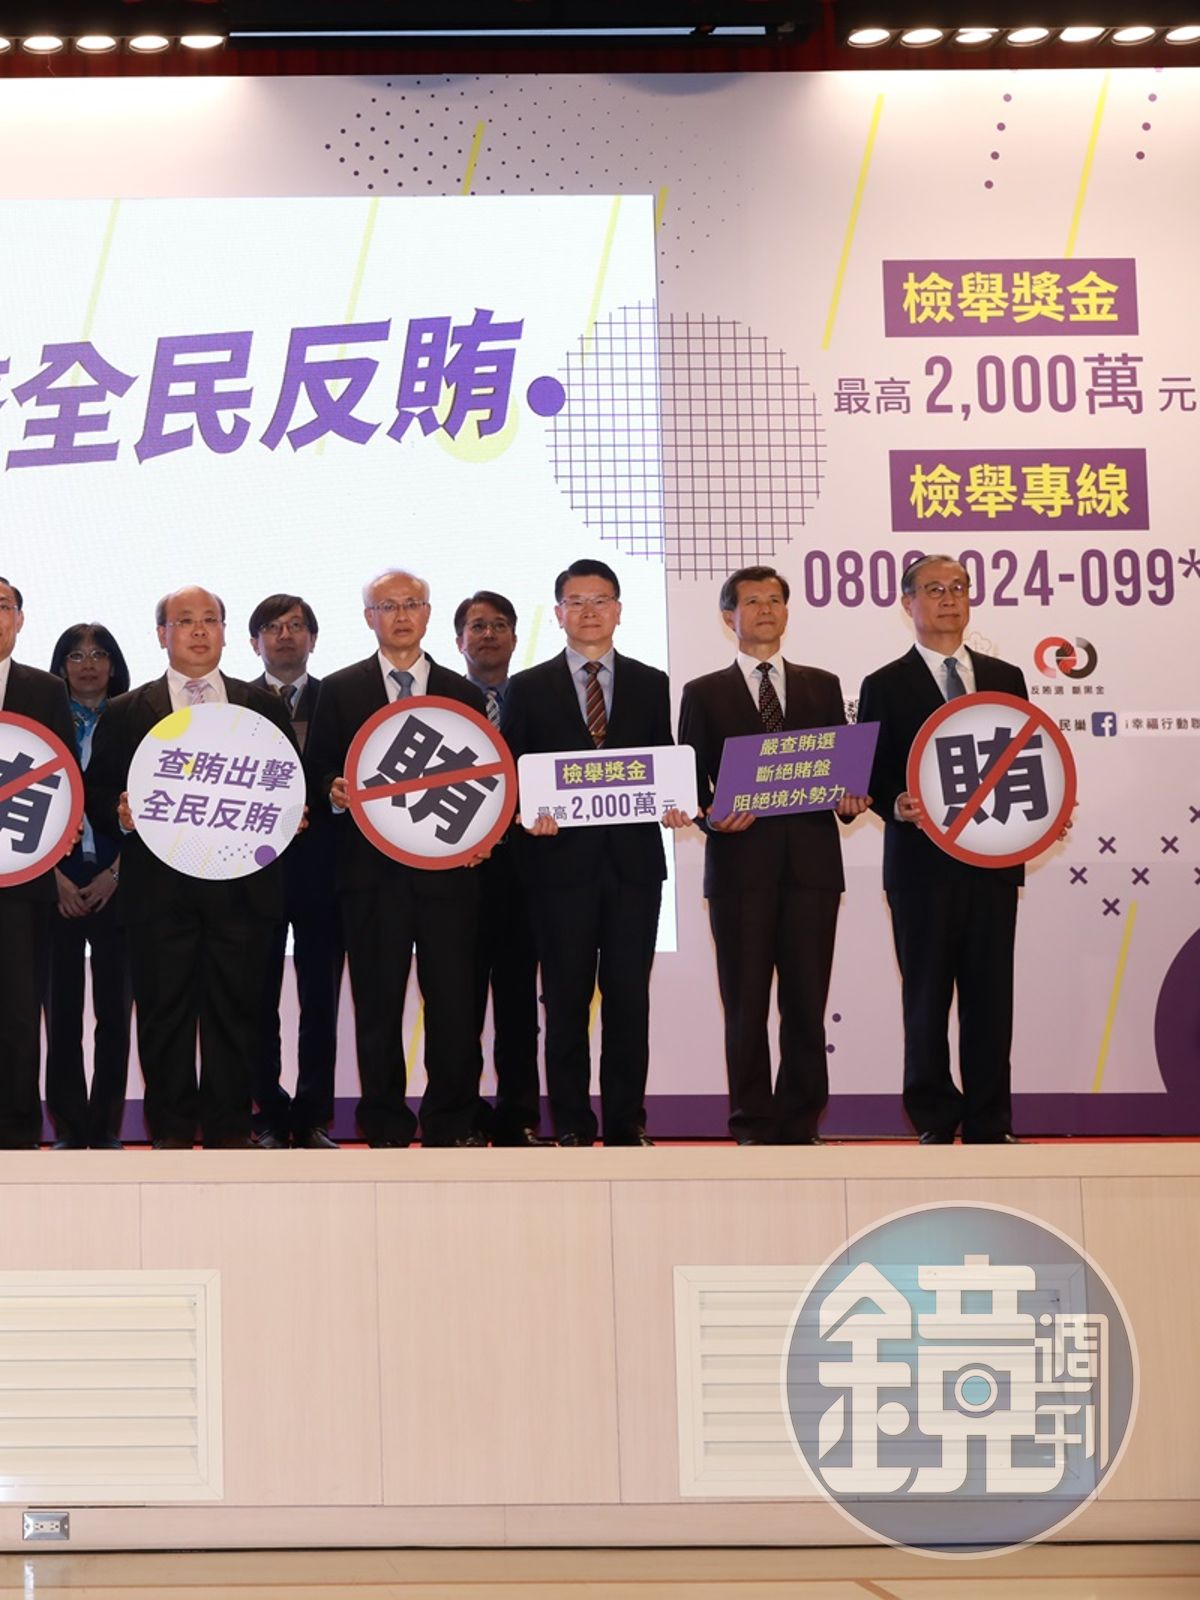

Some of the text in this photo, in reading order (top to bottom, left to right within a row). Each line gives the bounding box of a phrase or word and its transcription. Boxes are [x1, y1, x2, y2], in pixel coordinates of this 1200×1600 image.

[903, 271, 1120, 325] 檢舉獎金
[834, 377, 911, 415] 最高
[1159, 377, 1197, 412] 元
[909, 463, 1131, 519] 檢舉專線
[760, 732, 836, 756] 嚴查賄選
[154, 747, 297, 792] 查賄出擊
[362, 714, 499, 845] 賄
[562, 760, 647, 784] 檢舉獎金
[756, 759, 831, 782] 斷絕賭盤
[935, 727, 1050, 828] 賄
[138, 789, 282, 835] 全民反賄
[733, 784, 846, 812] 阻絕境外勢力
